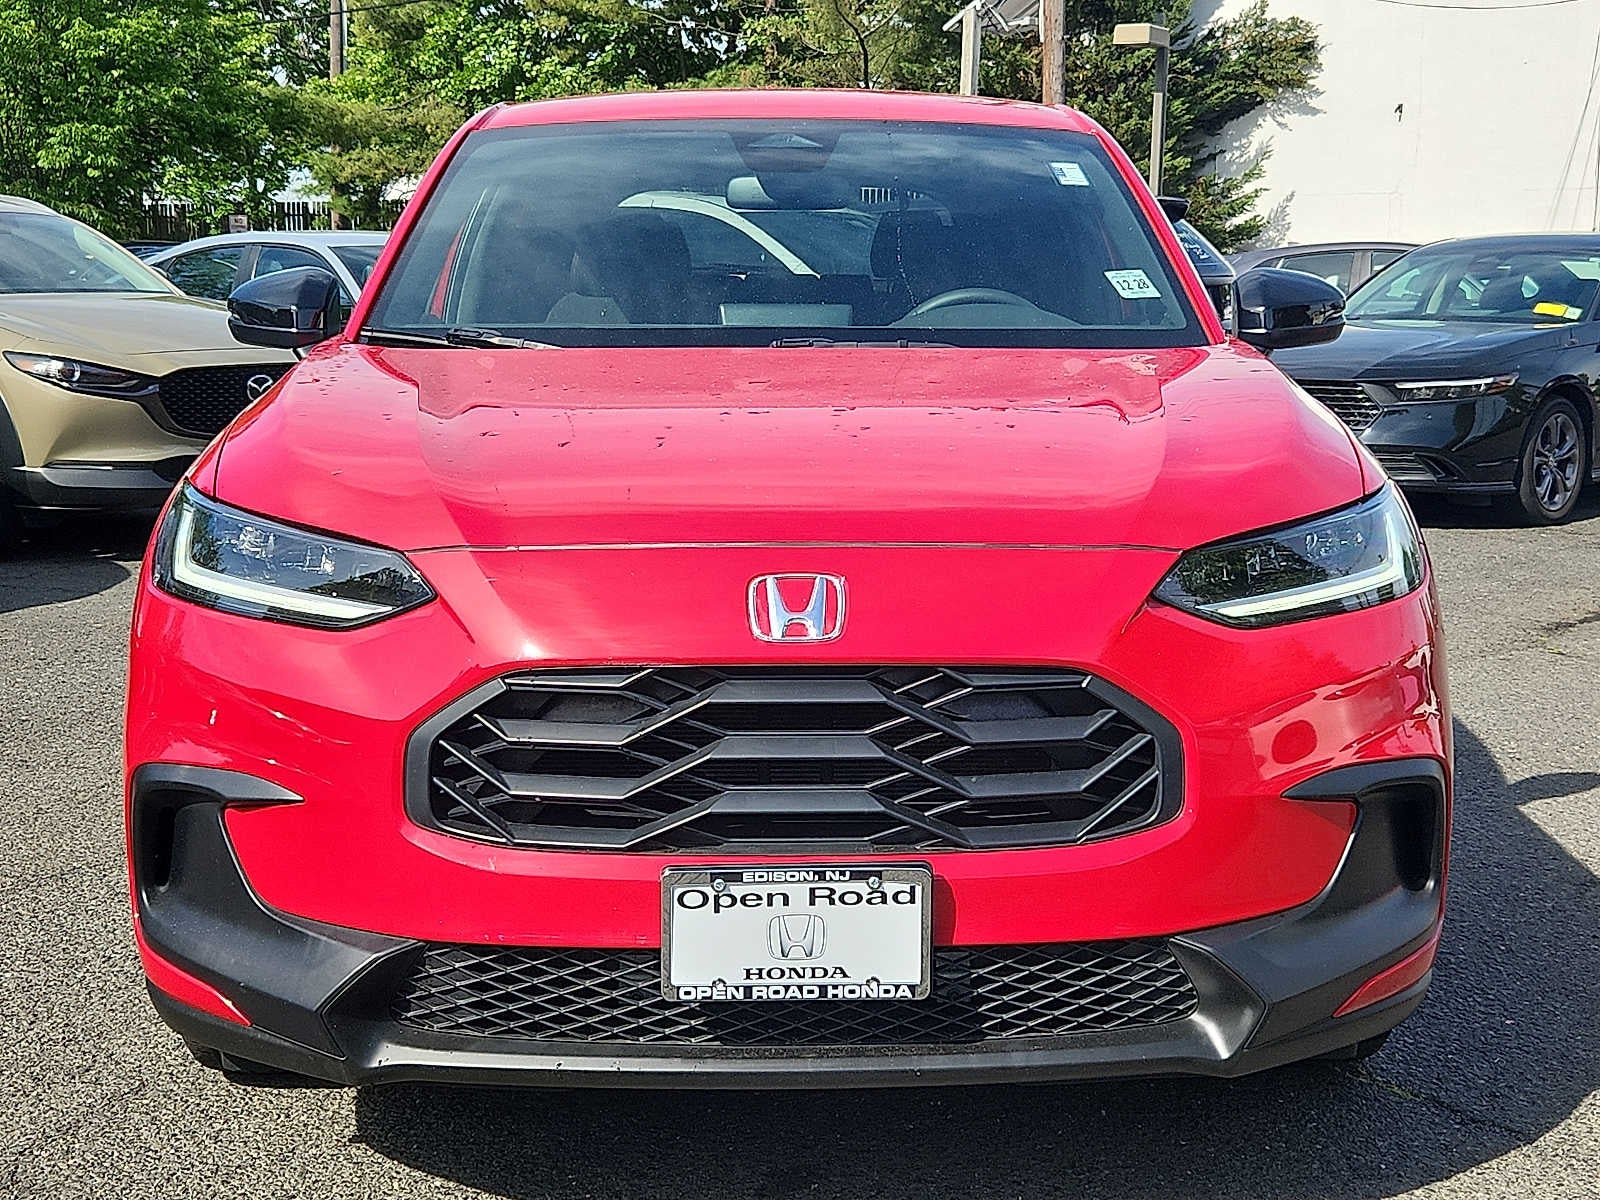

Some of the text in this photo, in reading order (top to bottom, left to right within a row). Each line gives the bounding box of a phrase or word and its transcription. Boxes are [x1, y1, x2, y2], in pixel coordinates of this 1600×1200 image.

[1116, 278, 1150, 291] 12 28
[742, 870, 851, 883] EDISON, NJ
[676, 885, 916, 914] Open Road
[743, 966, 852, 980] HONDA
[678, 984, 913, 1000] OPEN ROAD HONDA
